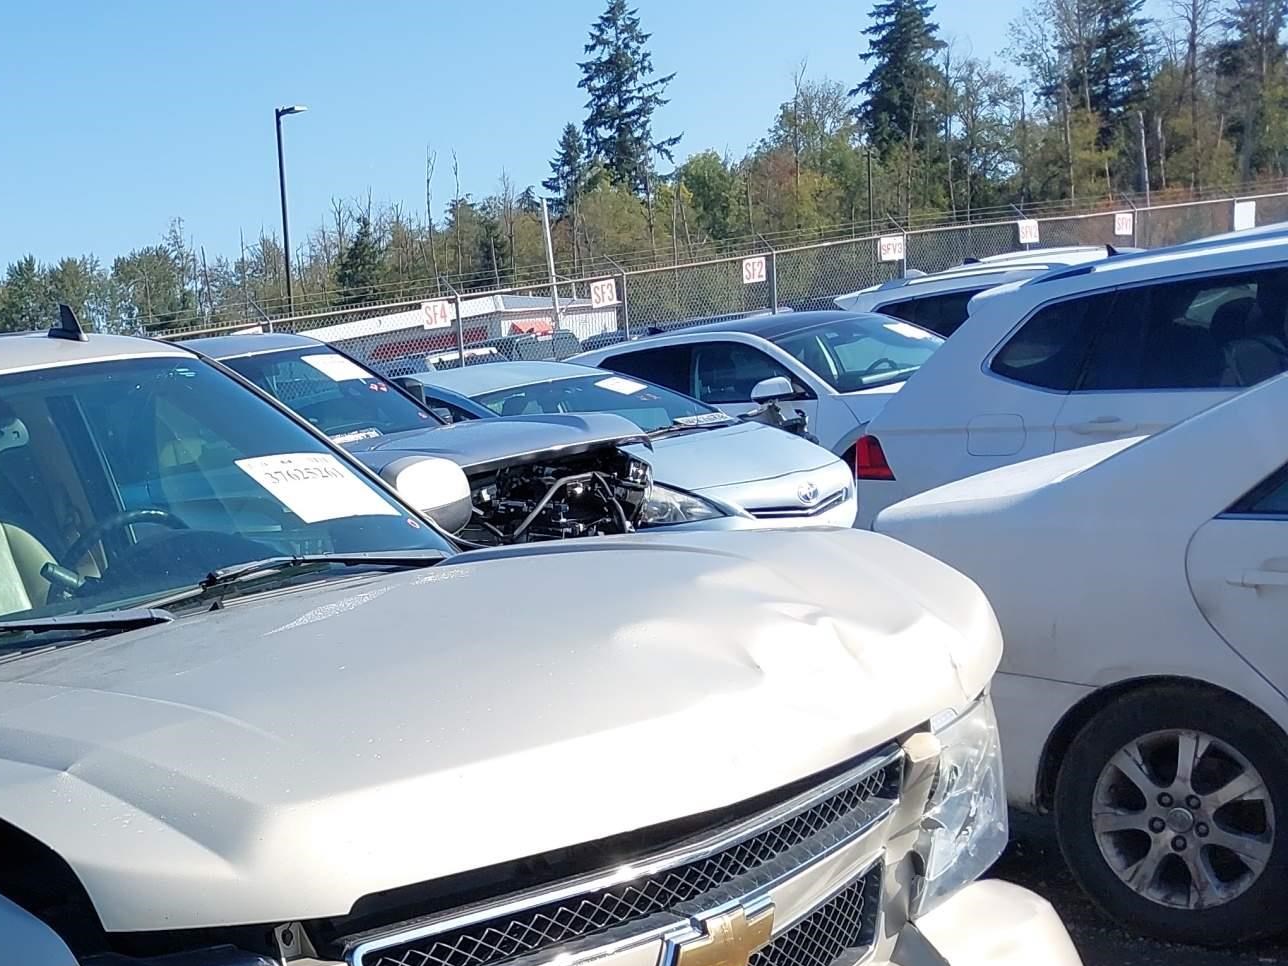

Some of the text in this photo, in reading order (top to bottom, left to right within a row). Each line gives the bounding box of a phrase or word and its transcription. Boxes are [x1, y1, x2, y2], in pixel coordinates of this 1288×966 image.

[882, 242, 903, 256] SFV3
[744, 260, 764, 280] SF2
[593, 282, 615, 305] SF3
[424, 303, 448, 326] SF4
